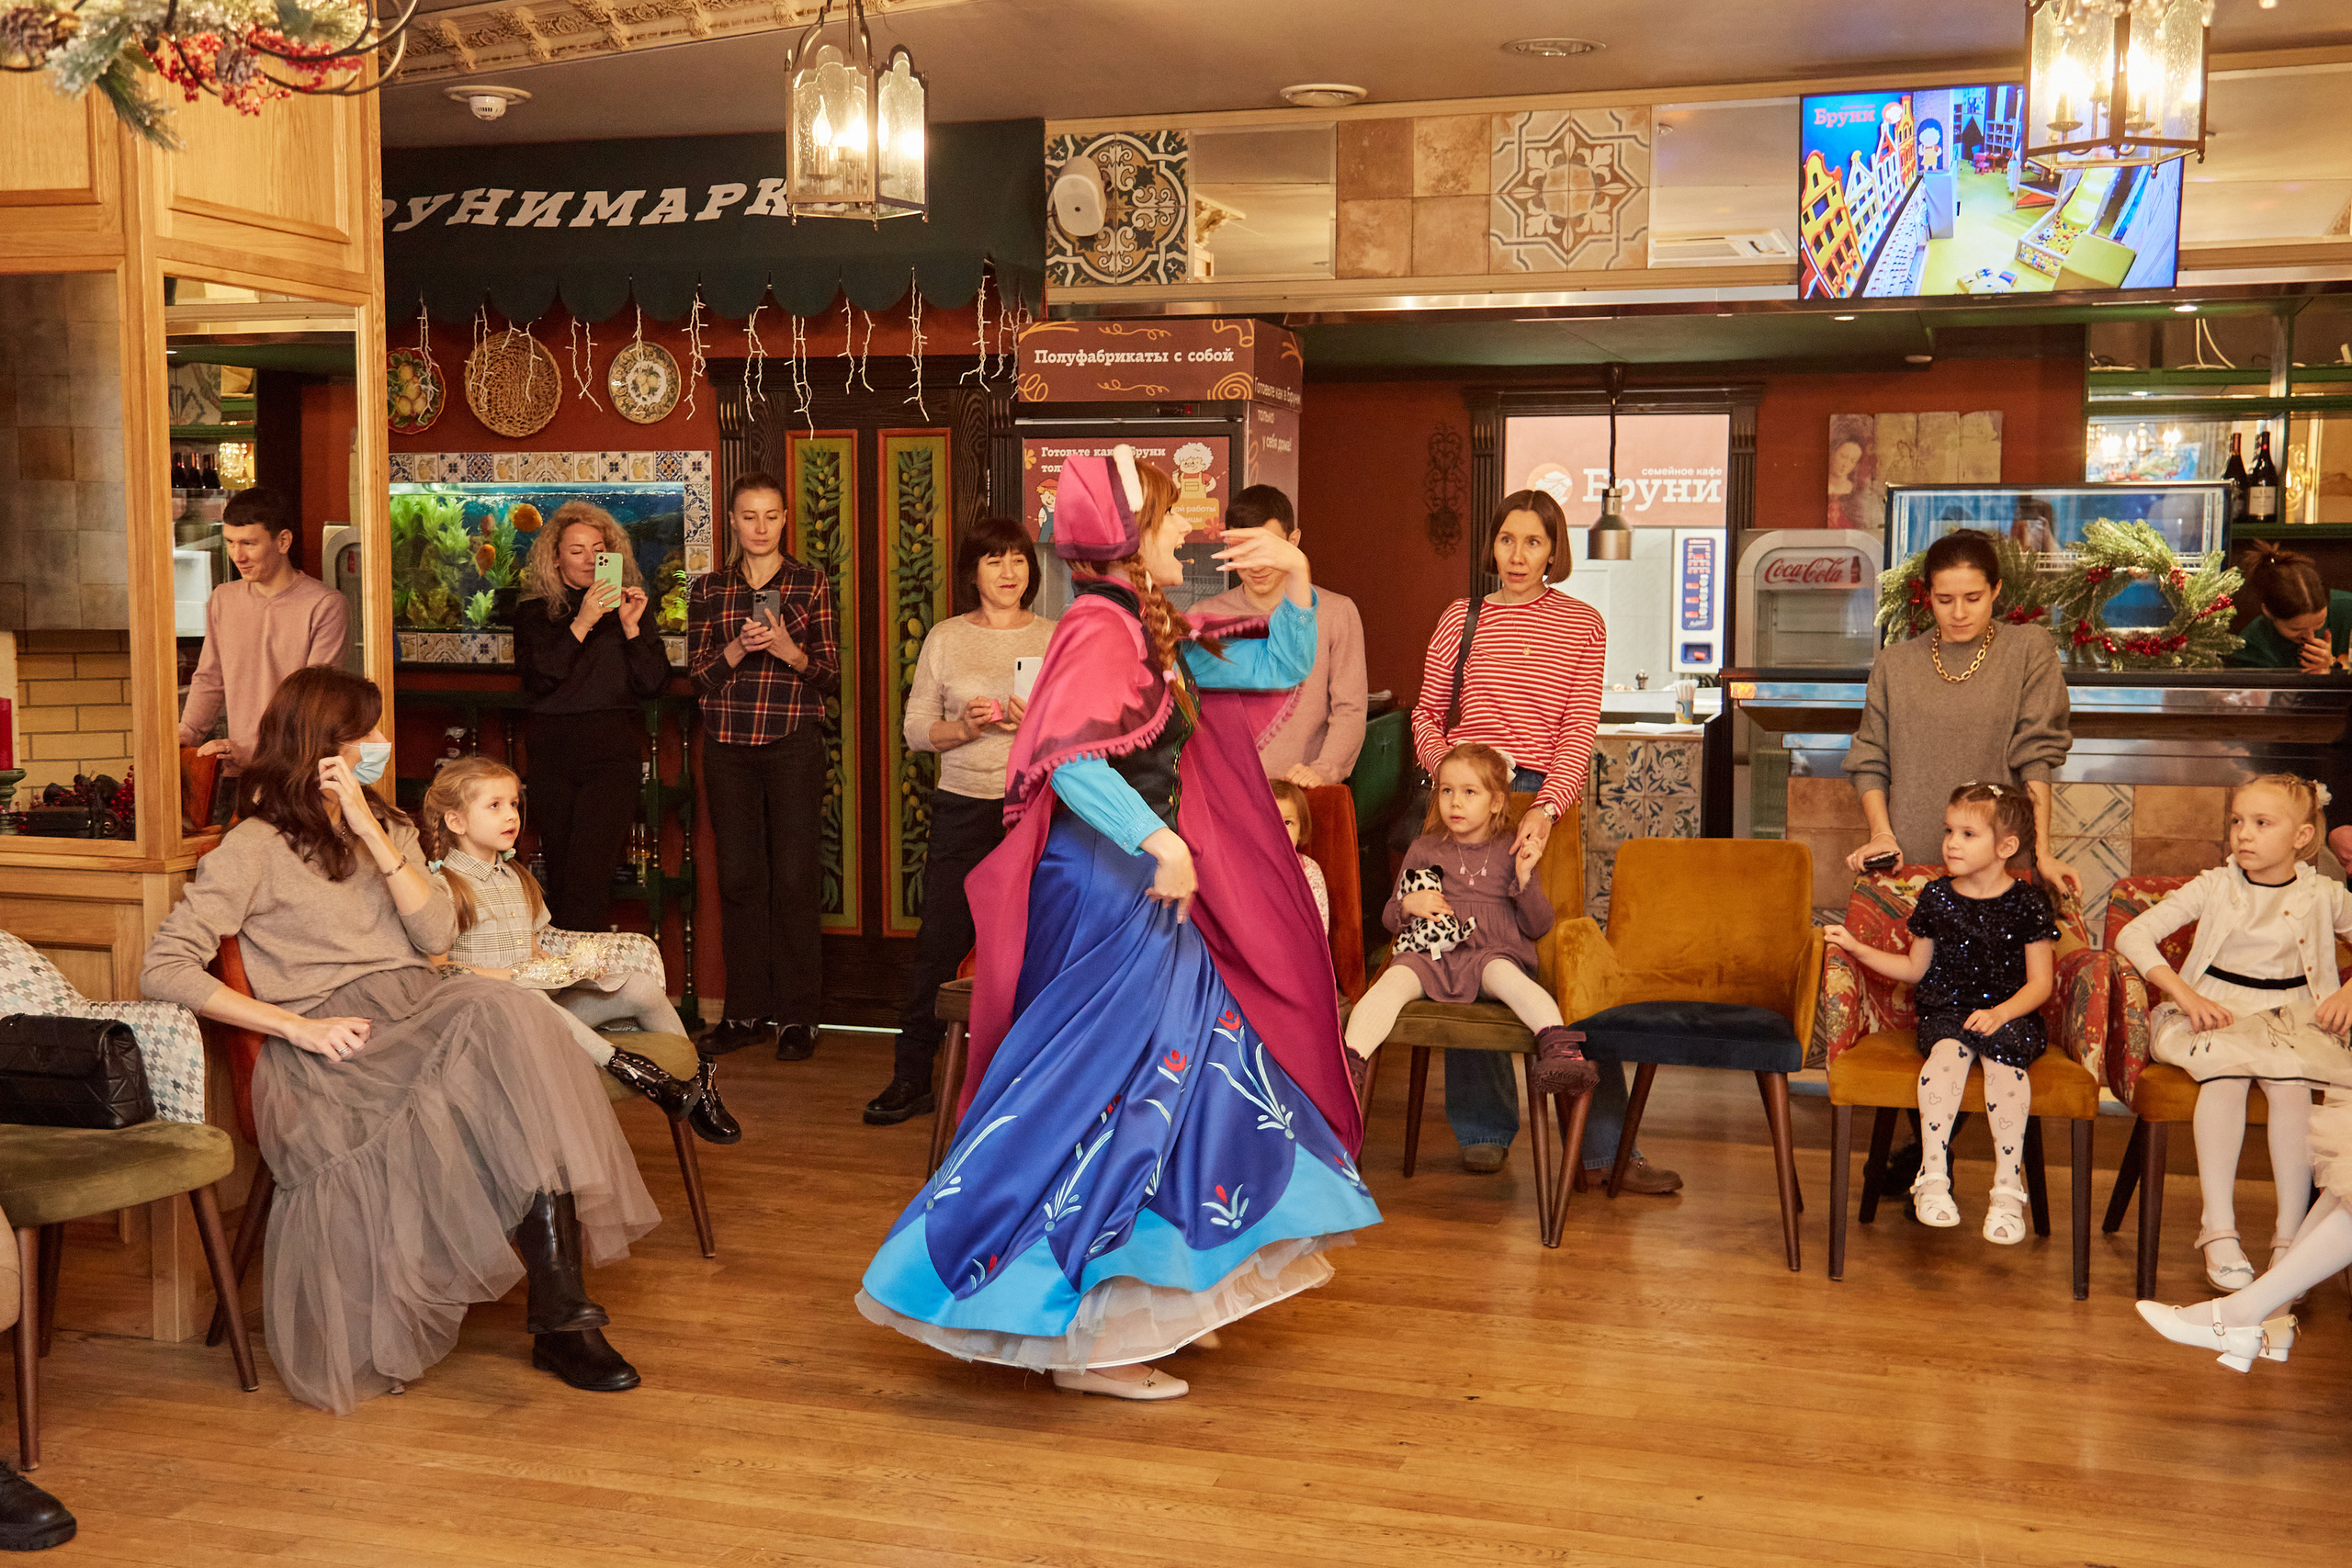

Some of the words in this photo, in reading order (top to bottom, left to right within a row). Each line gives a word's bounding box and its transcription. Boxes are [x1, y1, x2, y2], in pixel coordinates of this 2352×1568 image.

[1814, 107, 1875, 128] Бруни
[1034, 349, 1169, 367] Полуфабрикаты
[1173, 351, 1182, 362] с
[1187, 348, 1234, 362] собой
[1041, 446, 1091, 457] Готовьте
[1641, 466, 1694, 476] семейное
[1696, 466, 1723, 477] кафе
[1186, 504, 1216, 513] работы
[1764, 557, 1847, 584] Coca-Cola
